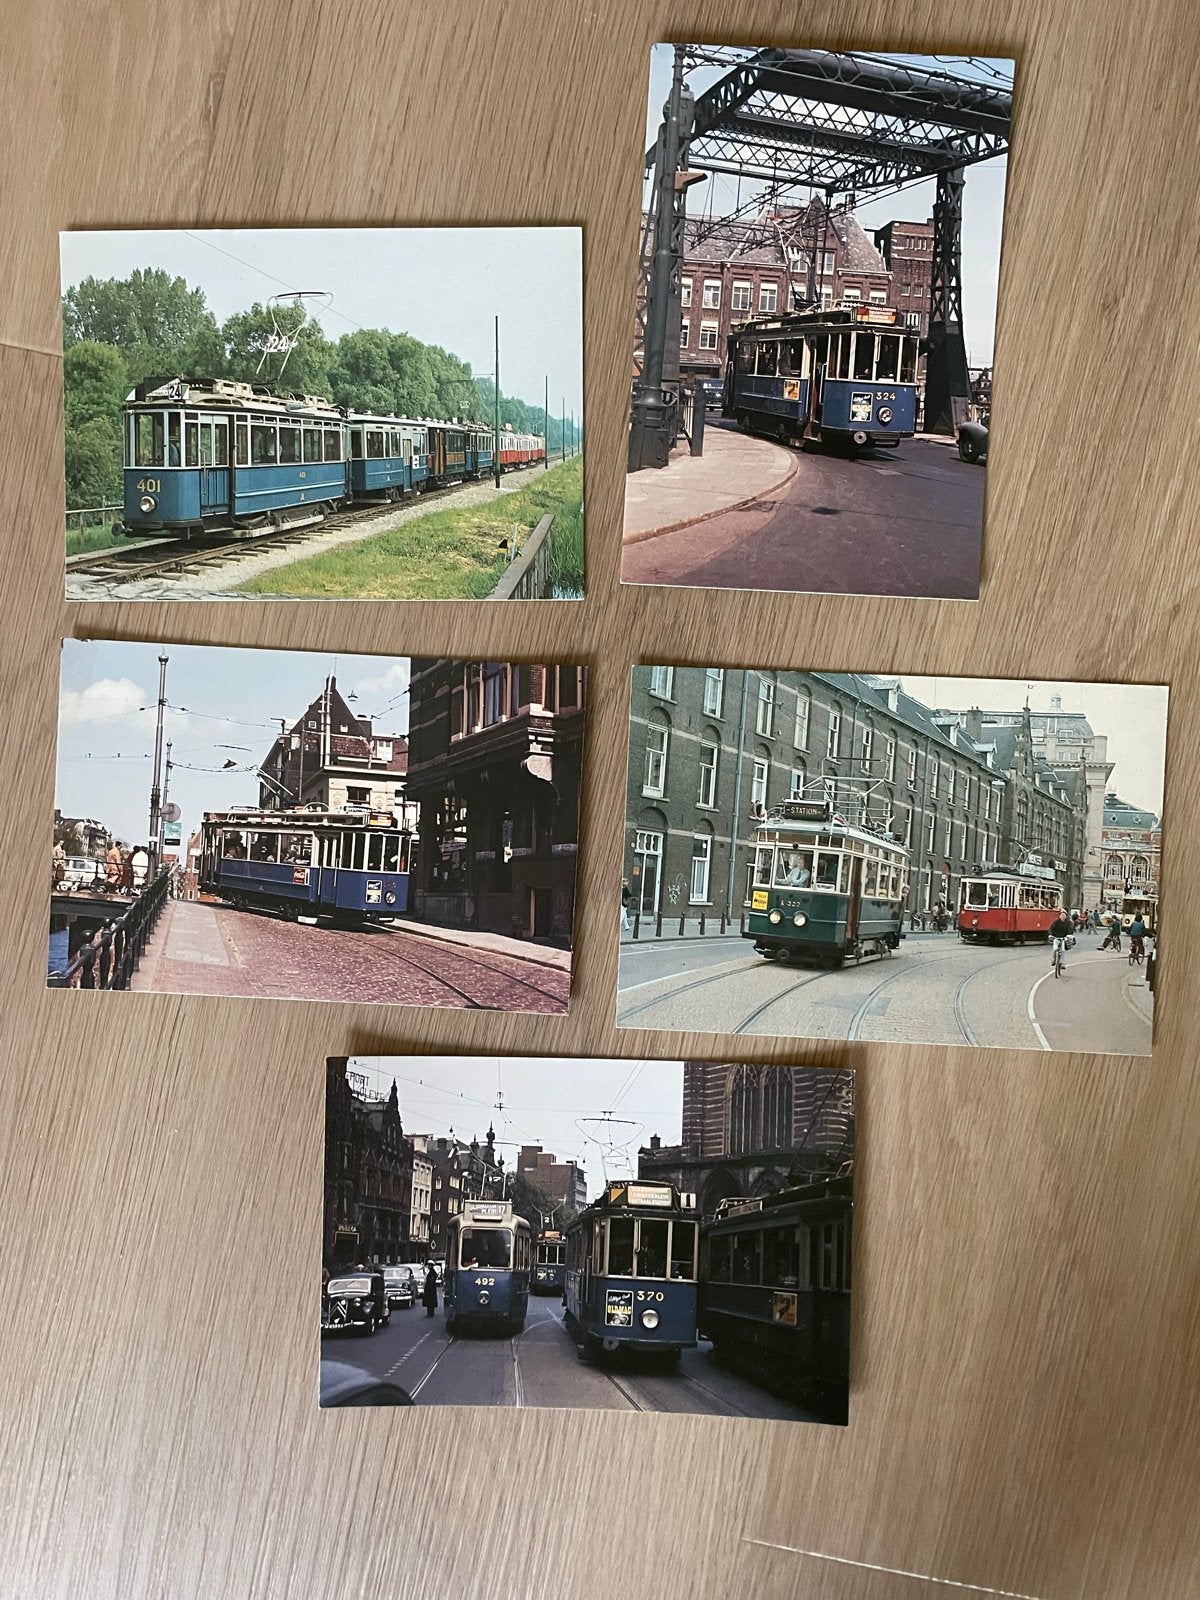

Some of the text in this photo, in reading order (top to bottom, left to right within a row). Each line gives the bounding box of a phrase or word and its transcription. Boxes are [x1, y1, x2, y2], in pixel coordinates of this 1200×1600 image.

[169, 385, 182, 399] 24
[875, 392, 897, 401] 324
[137, 478, 161, 493] 401
[790, 806, 818, 815] STATION
[350, 1072, 370, 1087] PORT
[685, 1193, 691, 1208] 1
[498, 1205, 506, 1215] 17
[475, 1277, 495, 1286] 492
[637, 1291, 664, 1302] 370
